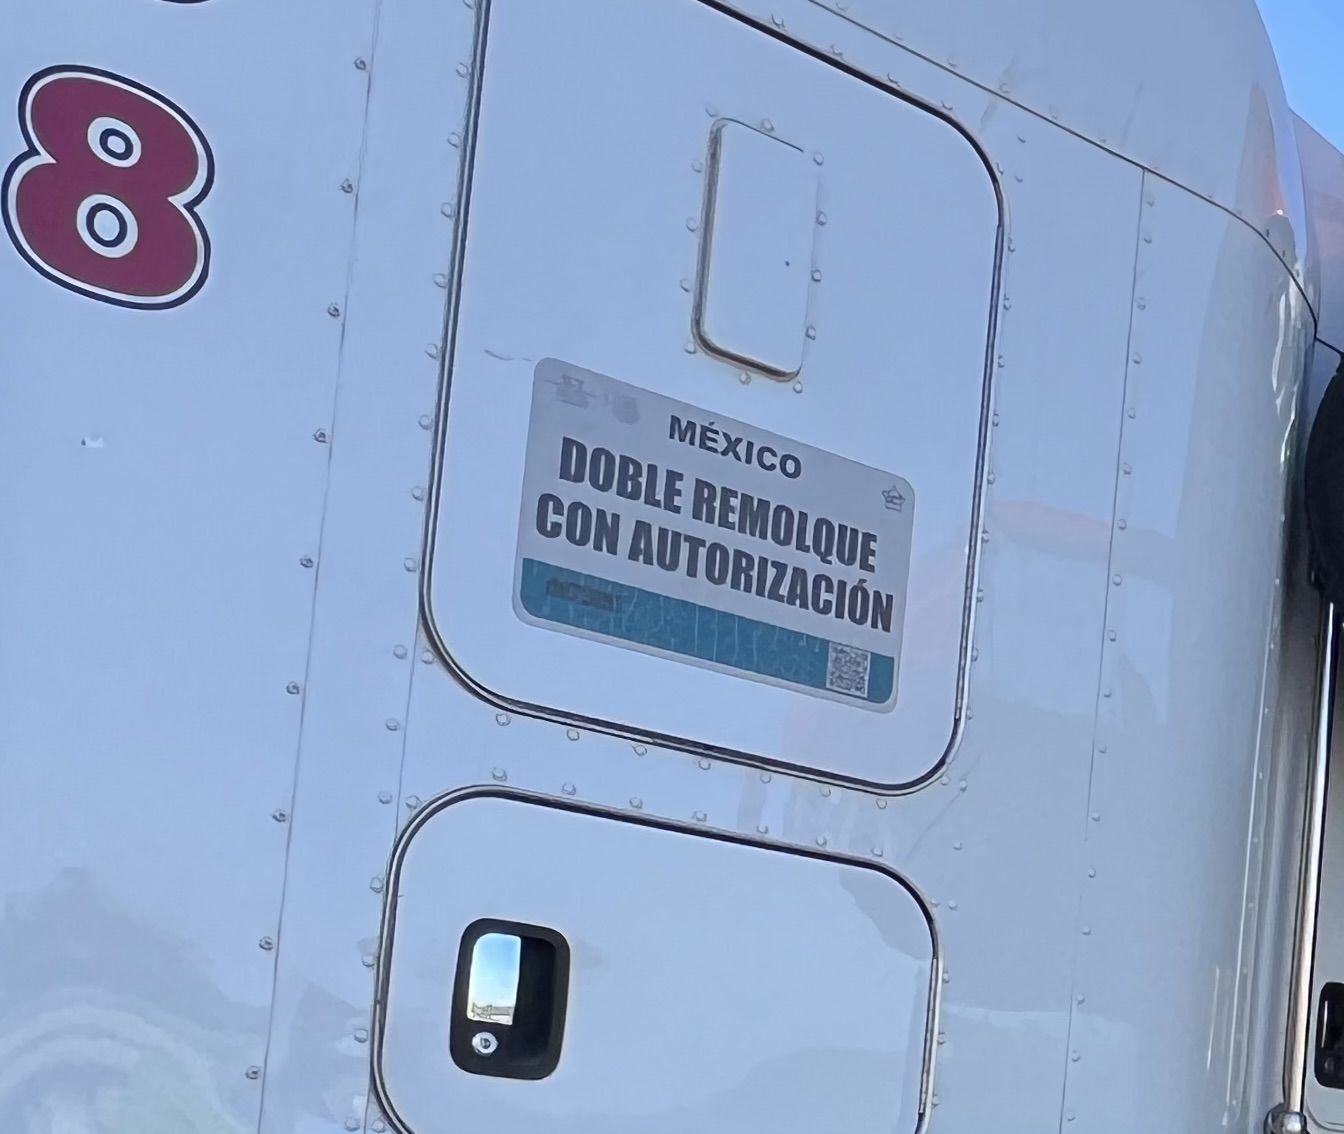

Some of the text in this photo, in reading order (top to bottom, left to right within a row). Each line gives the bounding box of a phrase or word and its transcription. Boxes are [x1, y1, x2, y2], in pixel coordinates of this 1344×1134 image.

[1, 64, 215, 311] 8
[559, 436, 878, 574] DOBLE REMOLQUE
[668, 414, 802, 480] MÉXICO
[536, 493, 894, 633] CON AUTORIZACIÓN
